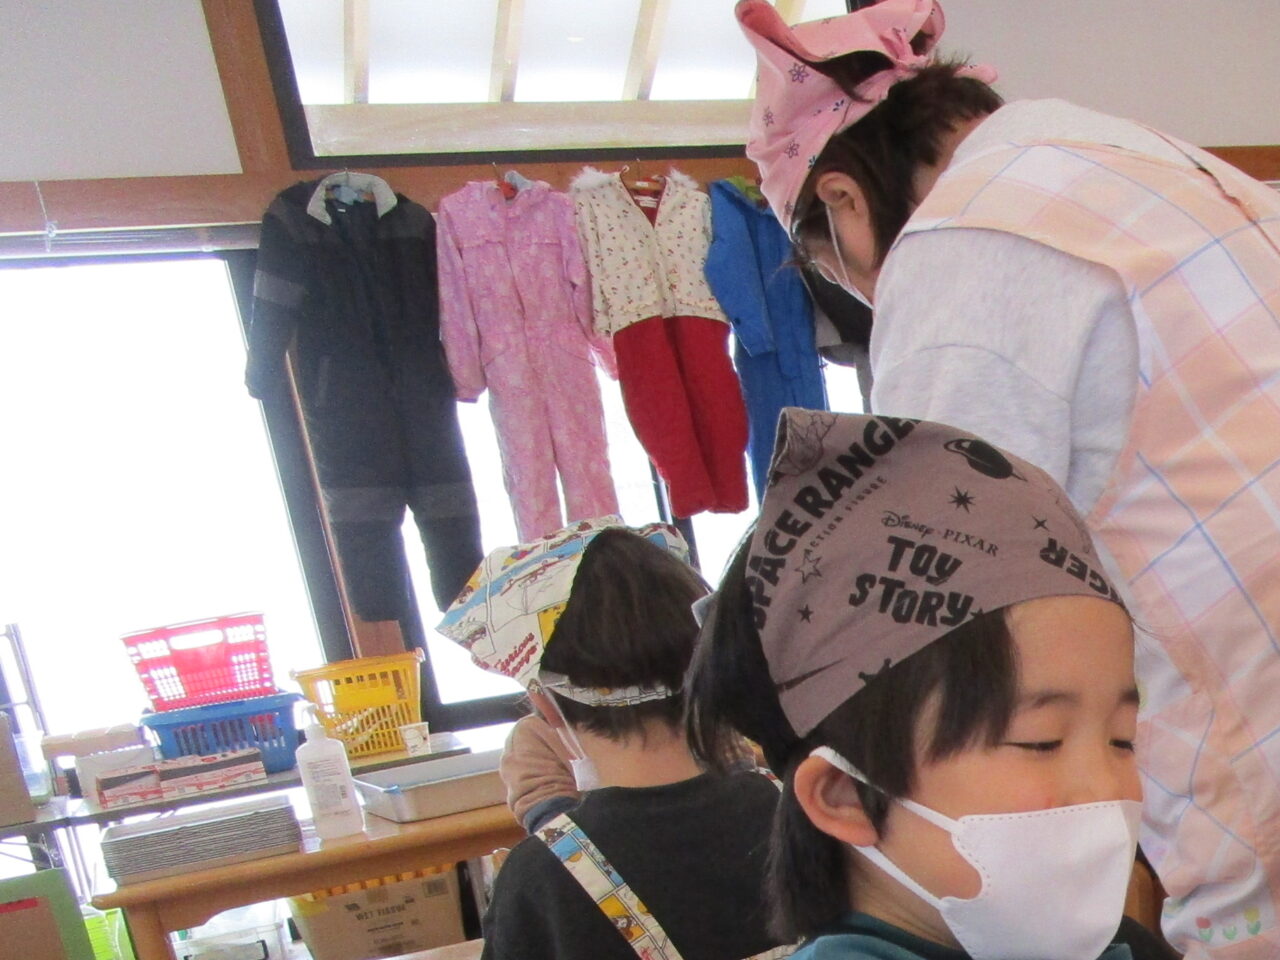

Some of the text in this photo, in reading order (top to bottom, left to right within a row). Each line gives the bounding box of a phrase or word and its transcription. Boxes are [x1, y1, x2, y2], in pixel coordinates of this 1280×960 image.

[793, 416, 921, 520] RANGE
[887, 535, 963, 587] TOY
[943, 527, 999, 558] PIXAR
[848, 572, 975, 627] STORY
